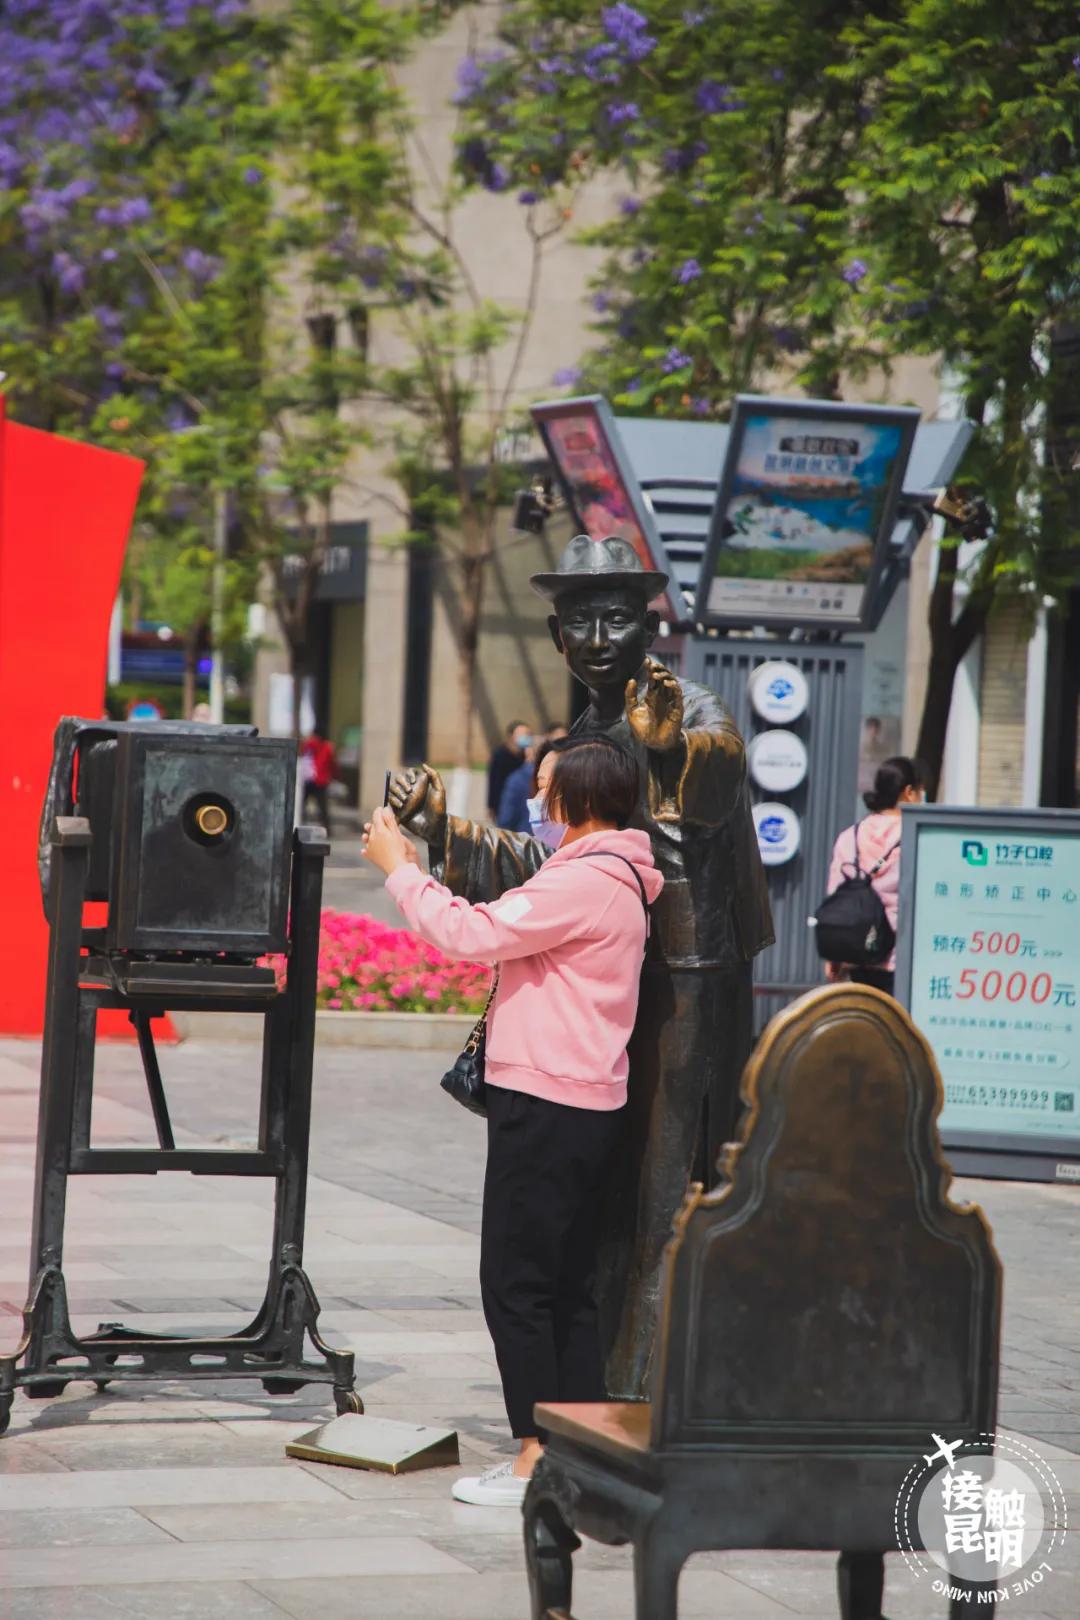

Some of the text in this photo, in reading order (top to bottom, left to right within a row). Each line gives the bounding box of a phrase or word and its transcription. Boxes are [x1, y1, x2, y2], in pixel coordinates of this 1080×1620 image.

[996, 844, 1054, 860] 竹子口腔
[933, 930, 1038, 957] 预存500元
[929, 968, 1076, 1007] 抵5000元
